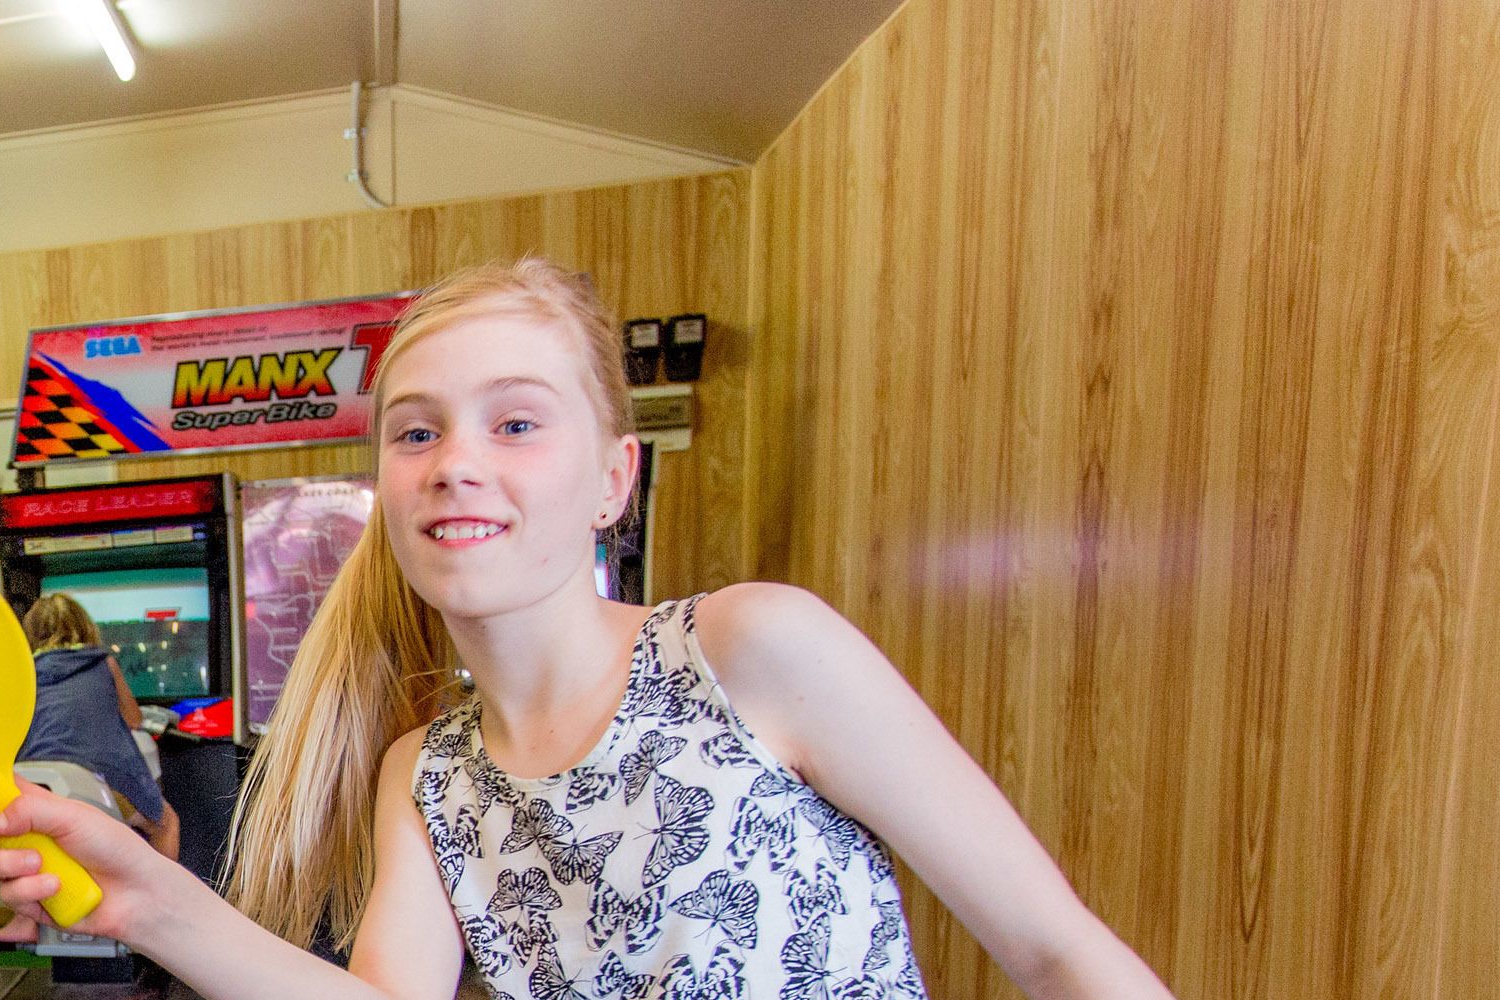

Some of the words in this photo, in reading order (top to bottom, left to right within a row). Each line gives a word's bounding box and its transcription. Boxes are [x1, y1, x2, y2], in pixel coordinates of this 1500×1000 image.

[85, 335, 141, 359] SEGA
[171, 347, 344, 409] MANX
[23, 499, 89, 517] RACE
[95, 491, 194, 512] LEADER
